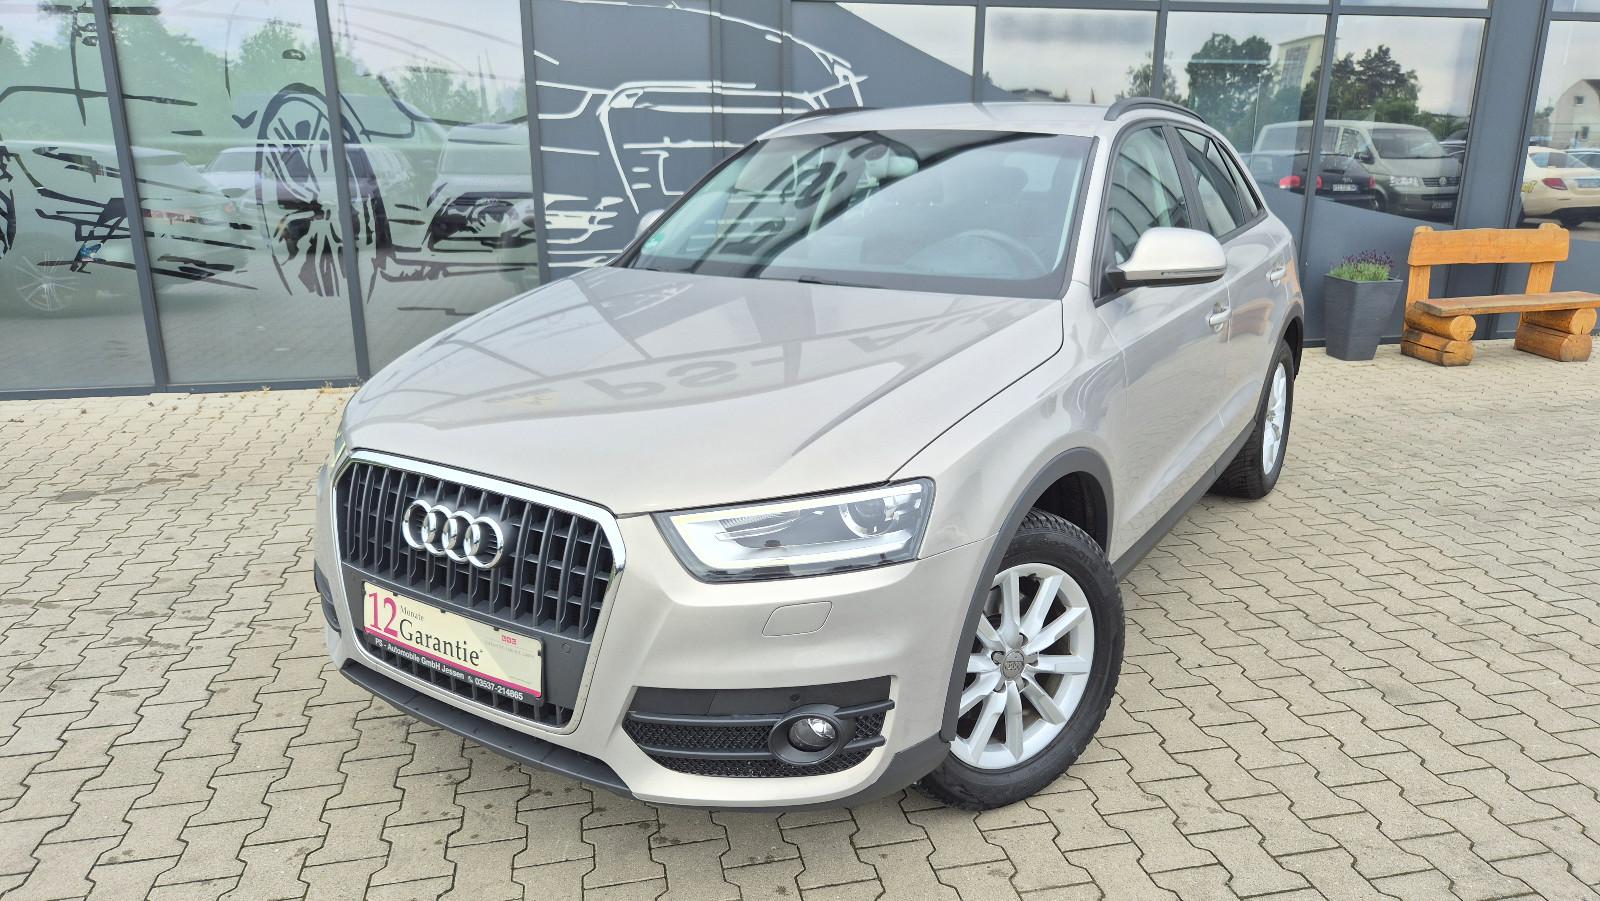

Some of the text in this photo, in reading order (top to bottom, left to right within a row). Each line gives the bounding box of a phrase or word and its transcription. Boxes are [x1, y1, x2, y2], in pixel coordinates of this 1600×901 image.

[368, 591, 398, 637] 12
[400, 605, 424, 621] Monate
[375, 637, 383, 647] PS
[387, 643, 420, 662] Automobile
[421, 656, 441, 670] GmbH
[441, 666, 464, 680] Jessen
[474, 677, 524, 700] 03537-214865
